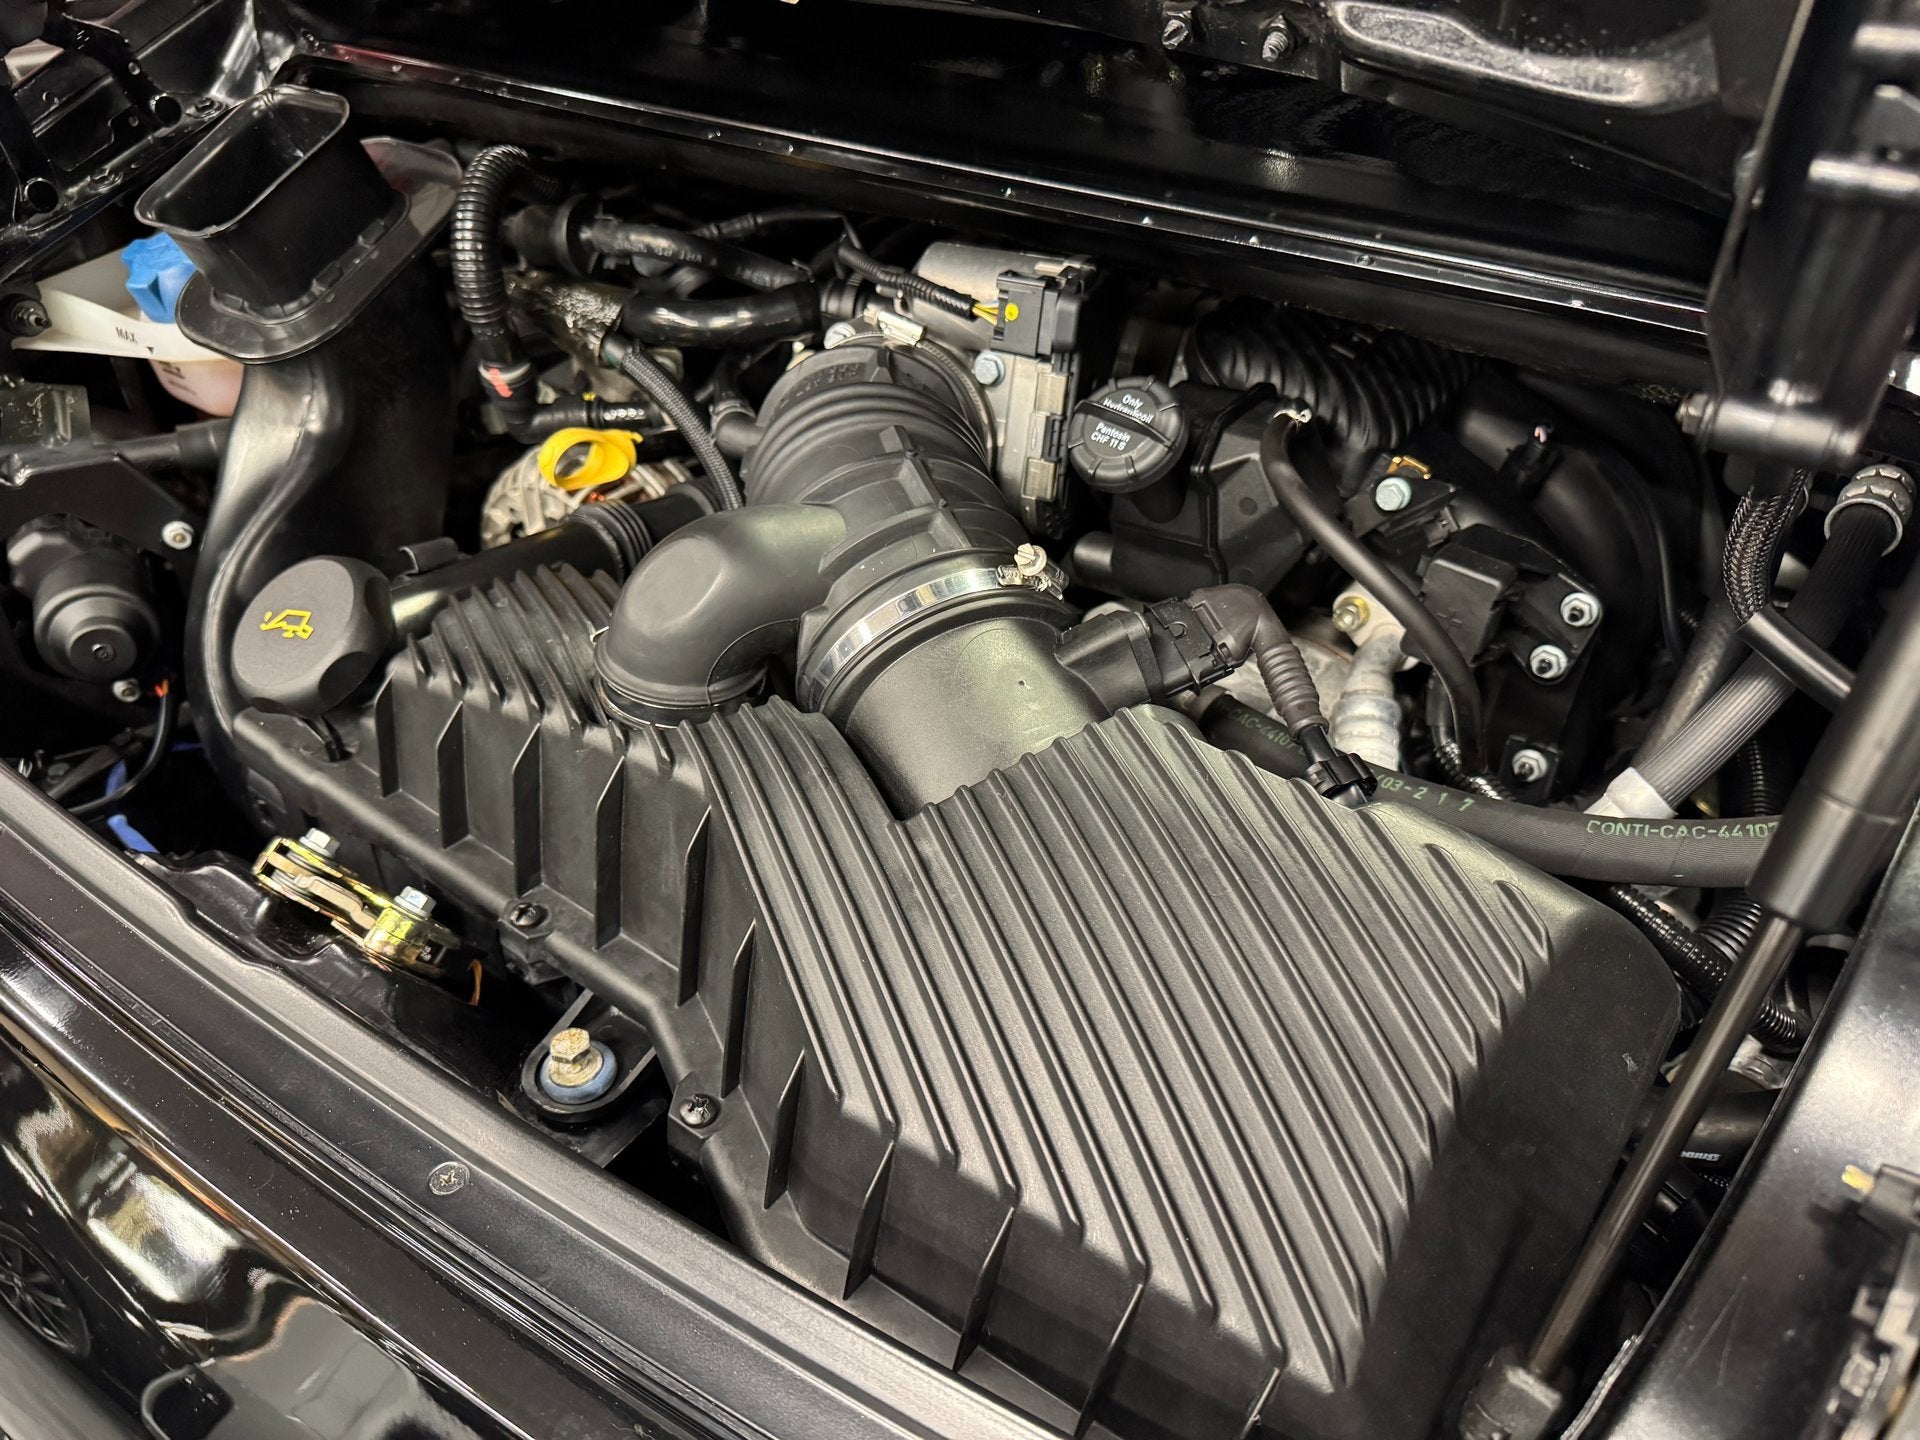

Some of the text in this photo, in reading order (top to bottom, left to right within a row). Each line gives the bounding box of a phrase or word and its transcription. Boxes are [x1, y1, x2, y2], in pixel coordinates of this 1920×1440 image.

[115, 326, 138, 344] MAX
[1122, 394, 1144, 410] Only
[1091, 431, 1109, 445] CHF
[1096, 422, 1131, 442] Pentosin
